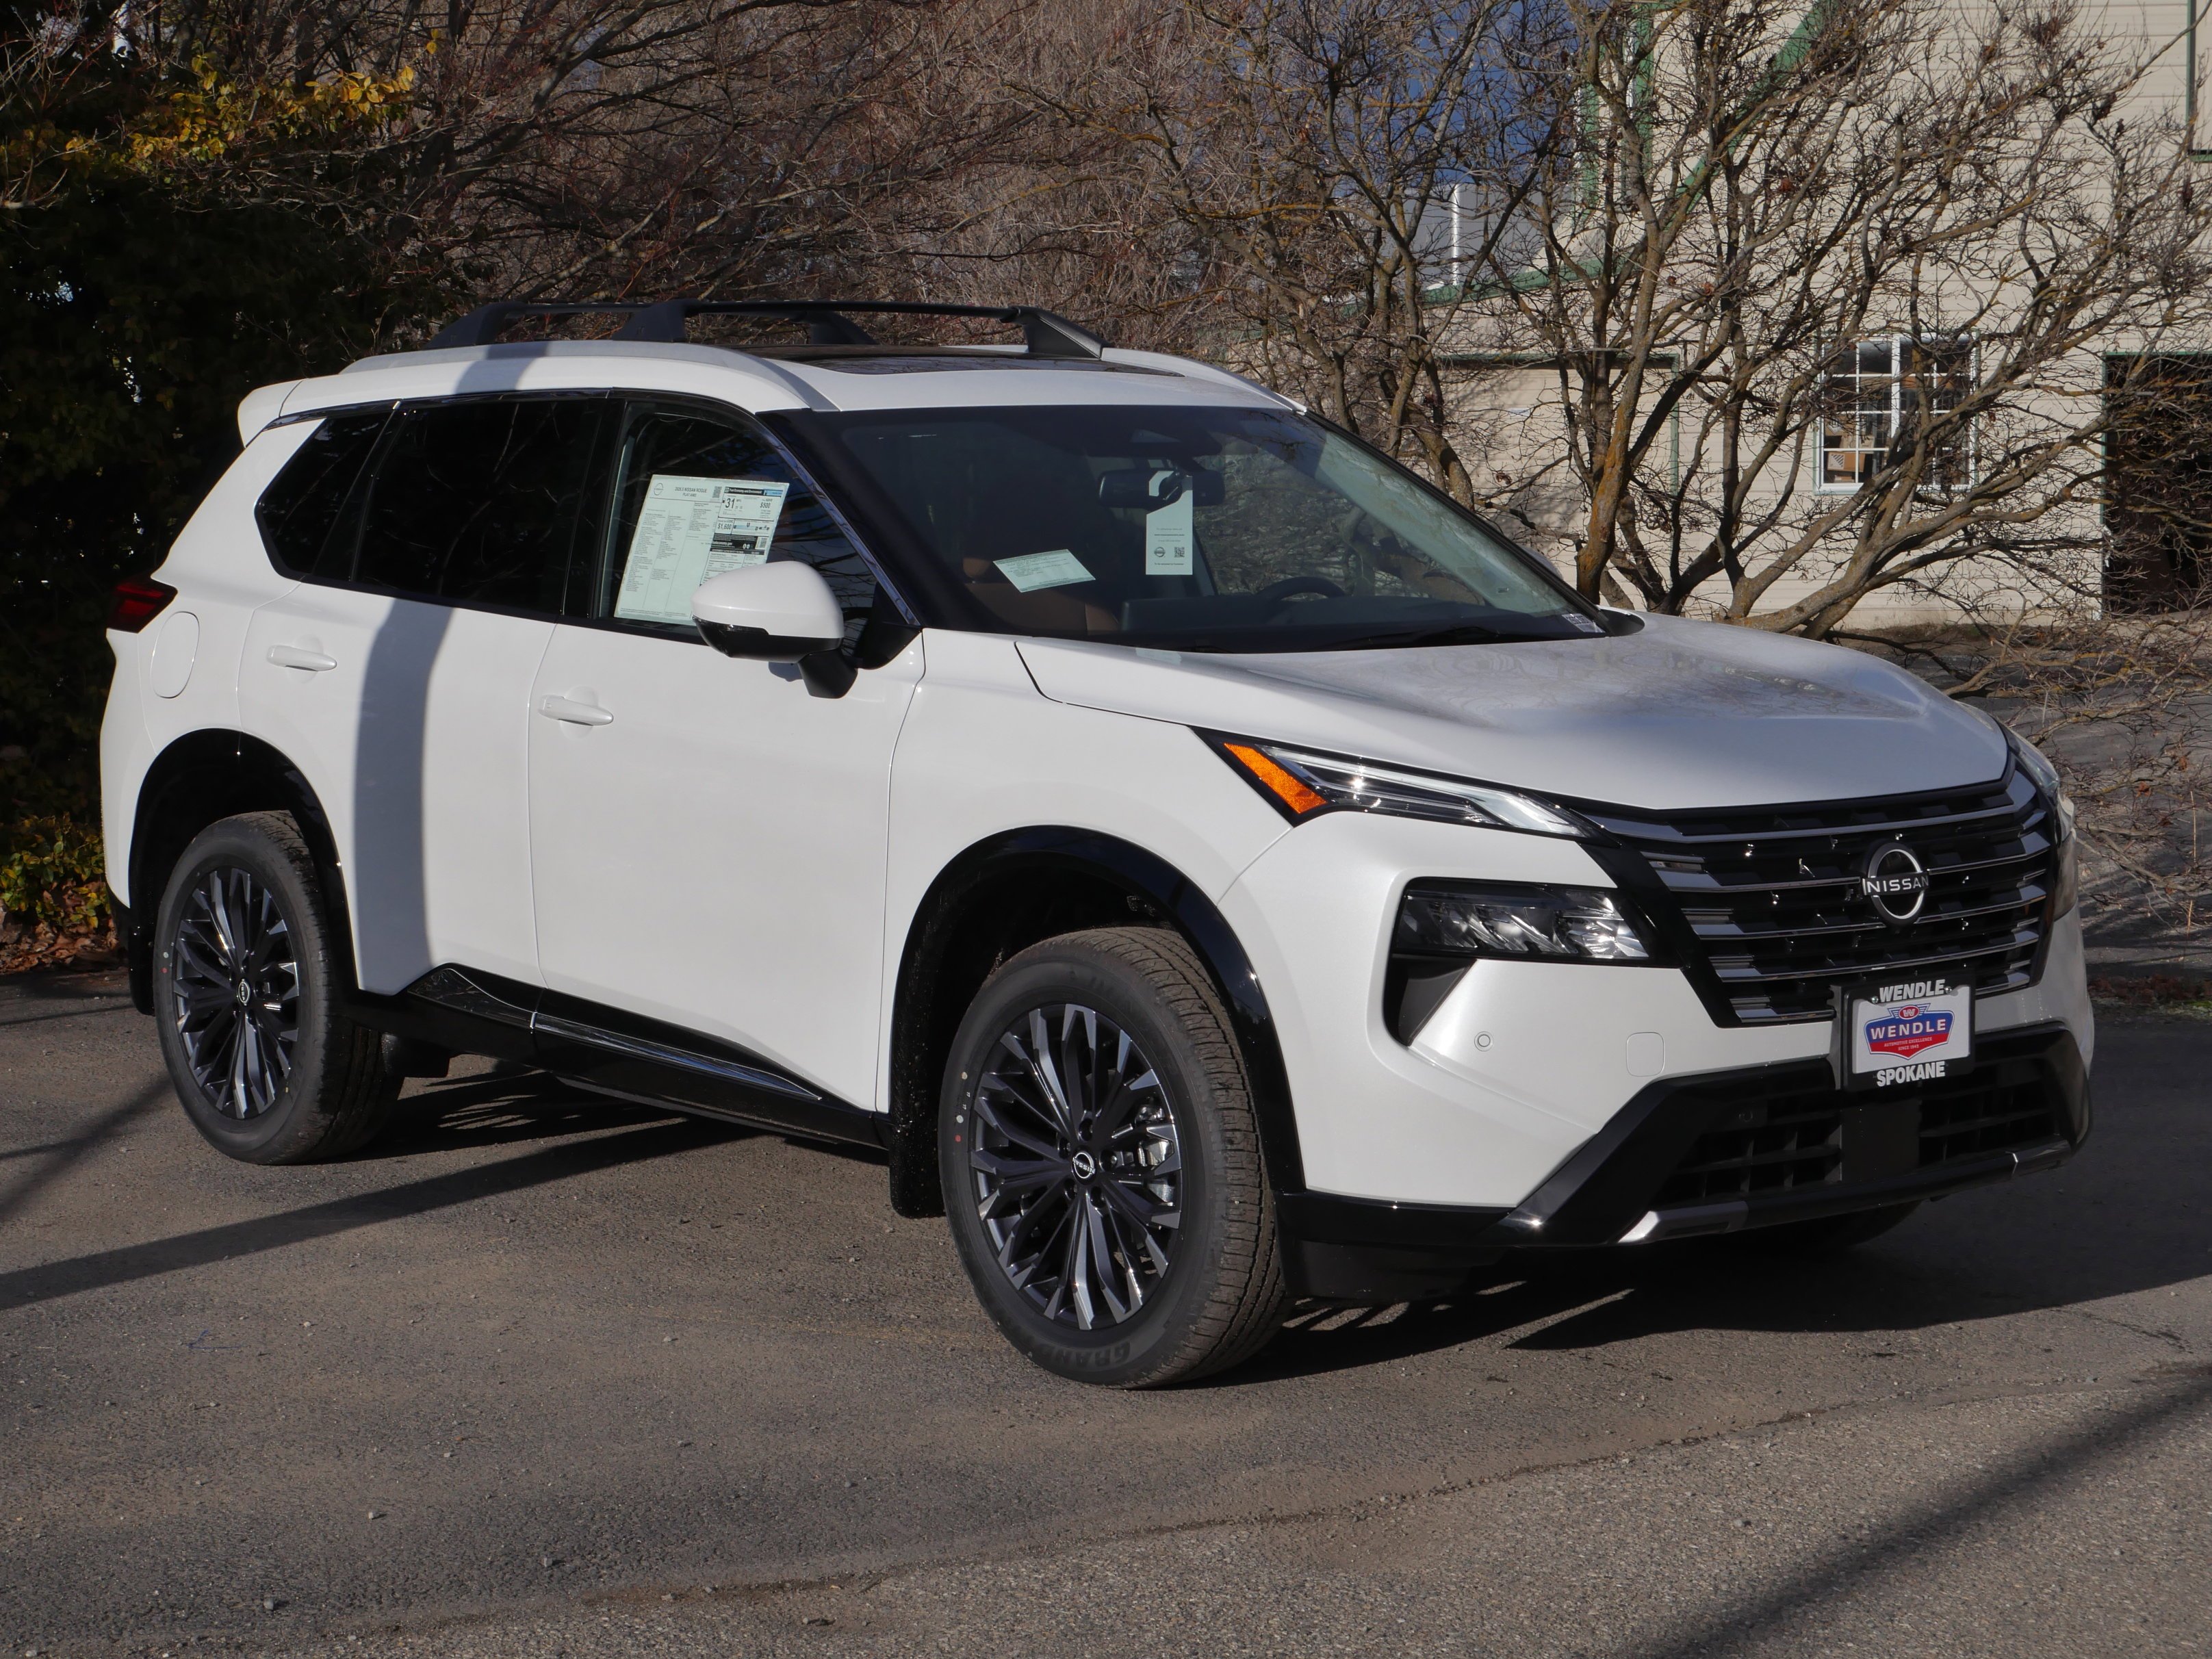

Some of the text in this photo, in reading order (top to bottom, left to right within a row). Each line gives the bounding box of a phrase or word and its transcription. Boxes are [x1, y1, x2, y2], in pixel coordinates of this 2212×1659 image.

[725, 498, 736, 509] 31
[1866, 875, 1929, 893] NISSAN
[1879, 979, 1945, 1003] WENDLE
[1870, 1018, 1946, 1040] WENDLE
[1883, 1036, 1933, 1048] AUTOMOTIVE EXCELLENCE
[1877, 1061, 1945, 1087] SPOKANE
